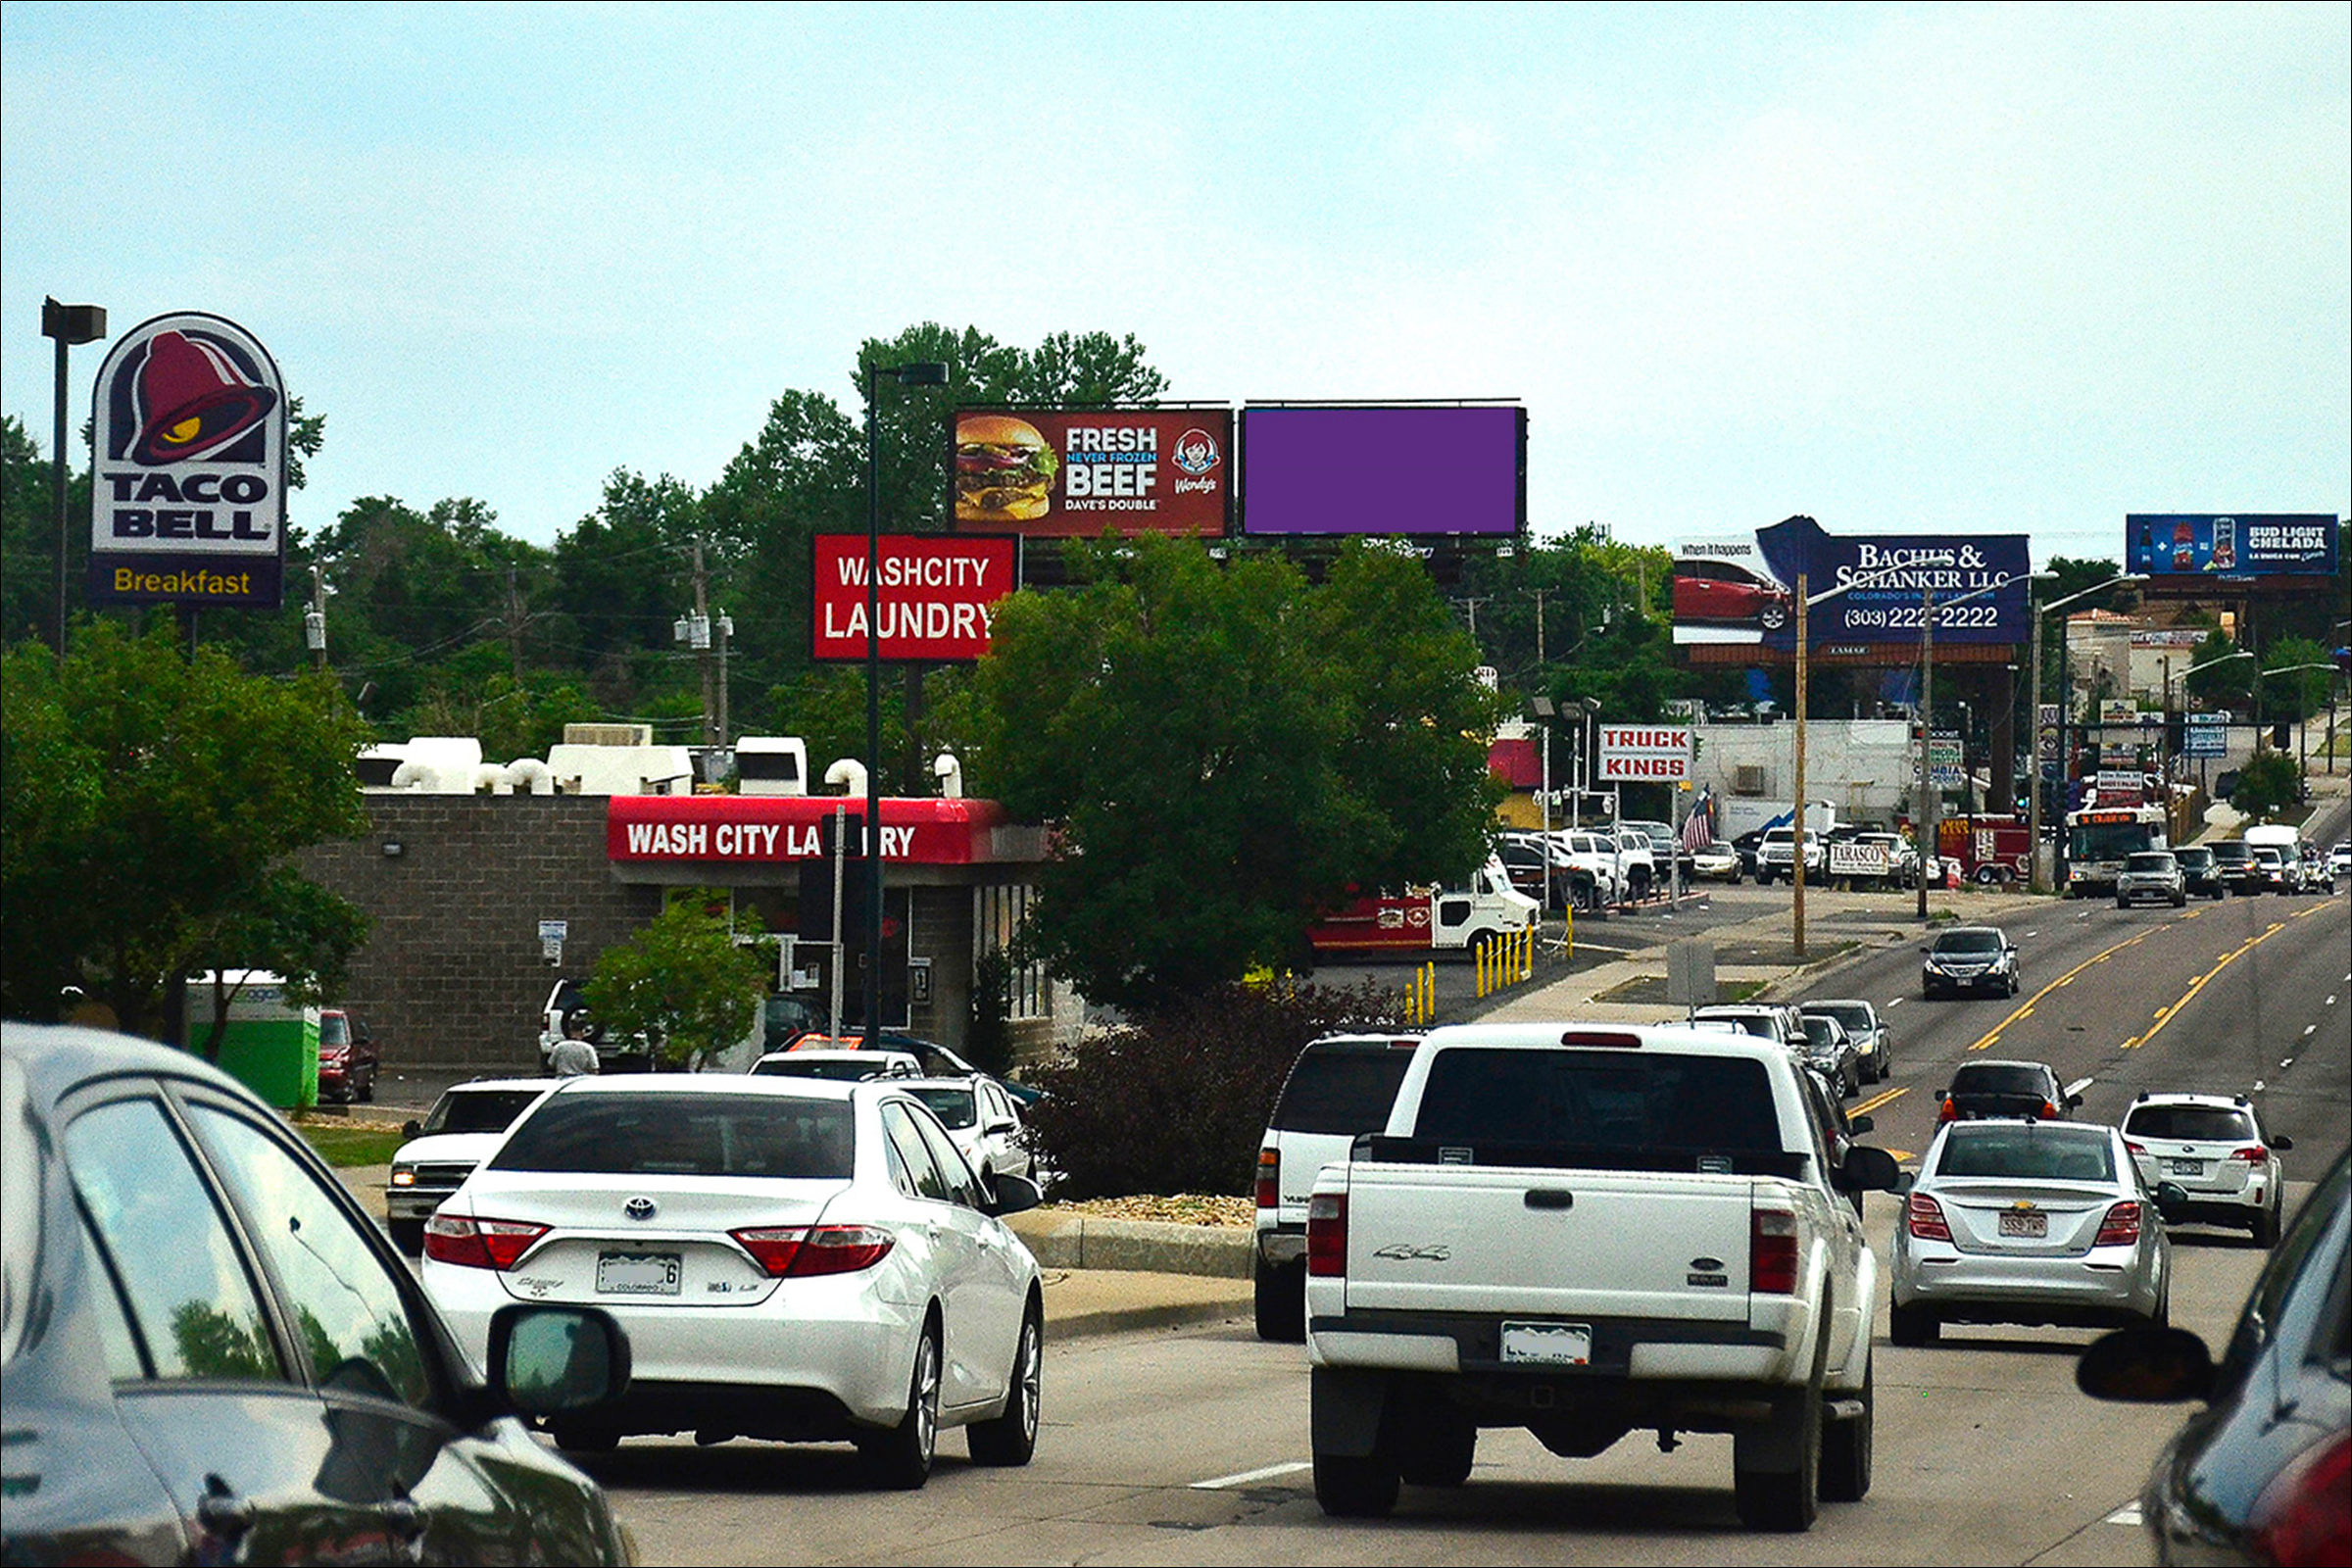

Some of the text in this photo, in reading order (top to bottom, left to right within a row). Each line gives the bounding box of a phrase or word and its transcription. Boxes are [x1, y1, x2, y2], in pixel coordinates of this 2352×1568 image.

[1066, 427, 1157, 452] FRESH
[1066, 452, 1157, 463] NEVER FROZEN
[102, 472, 268, 505] TACO
[1066, 464, 1157, 497] BEEF
[1174, 476, 1216, 494] Wendy's
[1065, 499, 1156, 511] DAVE'S DOUBLE
[113, 509, 271, 540] BELL
[2248, 526, 2326, 537] BUD LIGHT
[1714, 543, 1751, 557] happens
[2248, 538, 2328, 549] CHELADA
[1858, 544, 1987, 568] BACHUS &
[114, 567, 250, 594] Breakfast
[1836, 565, 2009, 589] SCHANKER LLC
[1847, 592, 1910, 601] COLORADO'S
[1912, 592, 1945, 601] INRY
[825, 603, 999, 639] LAUNDRY
[1844, 607, 1998, 628] (303) 222-2222
[1603, 731, 1688, 748] TRUCK
[1606, 759, 1685, 776] KINGS
[627, 824, 915, 858] WASH CITY LARY
